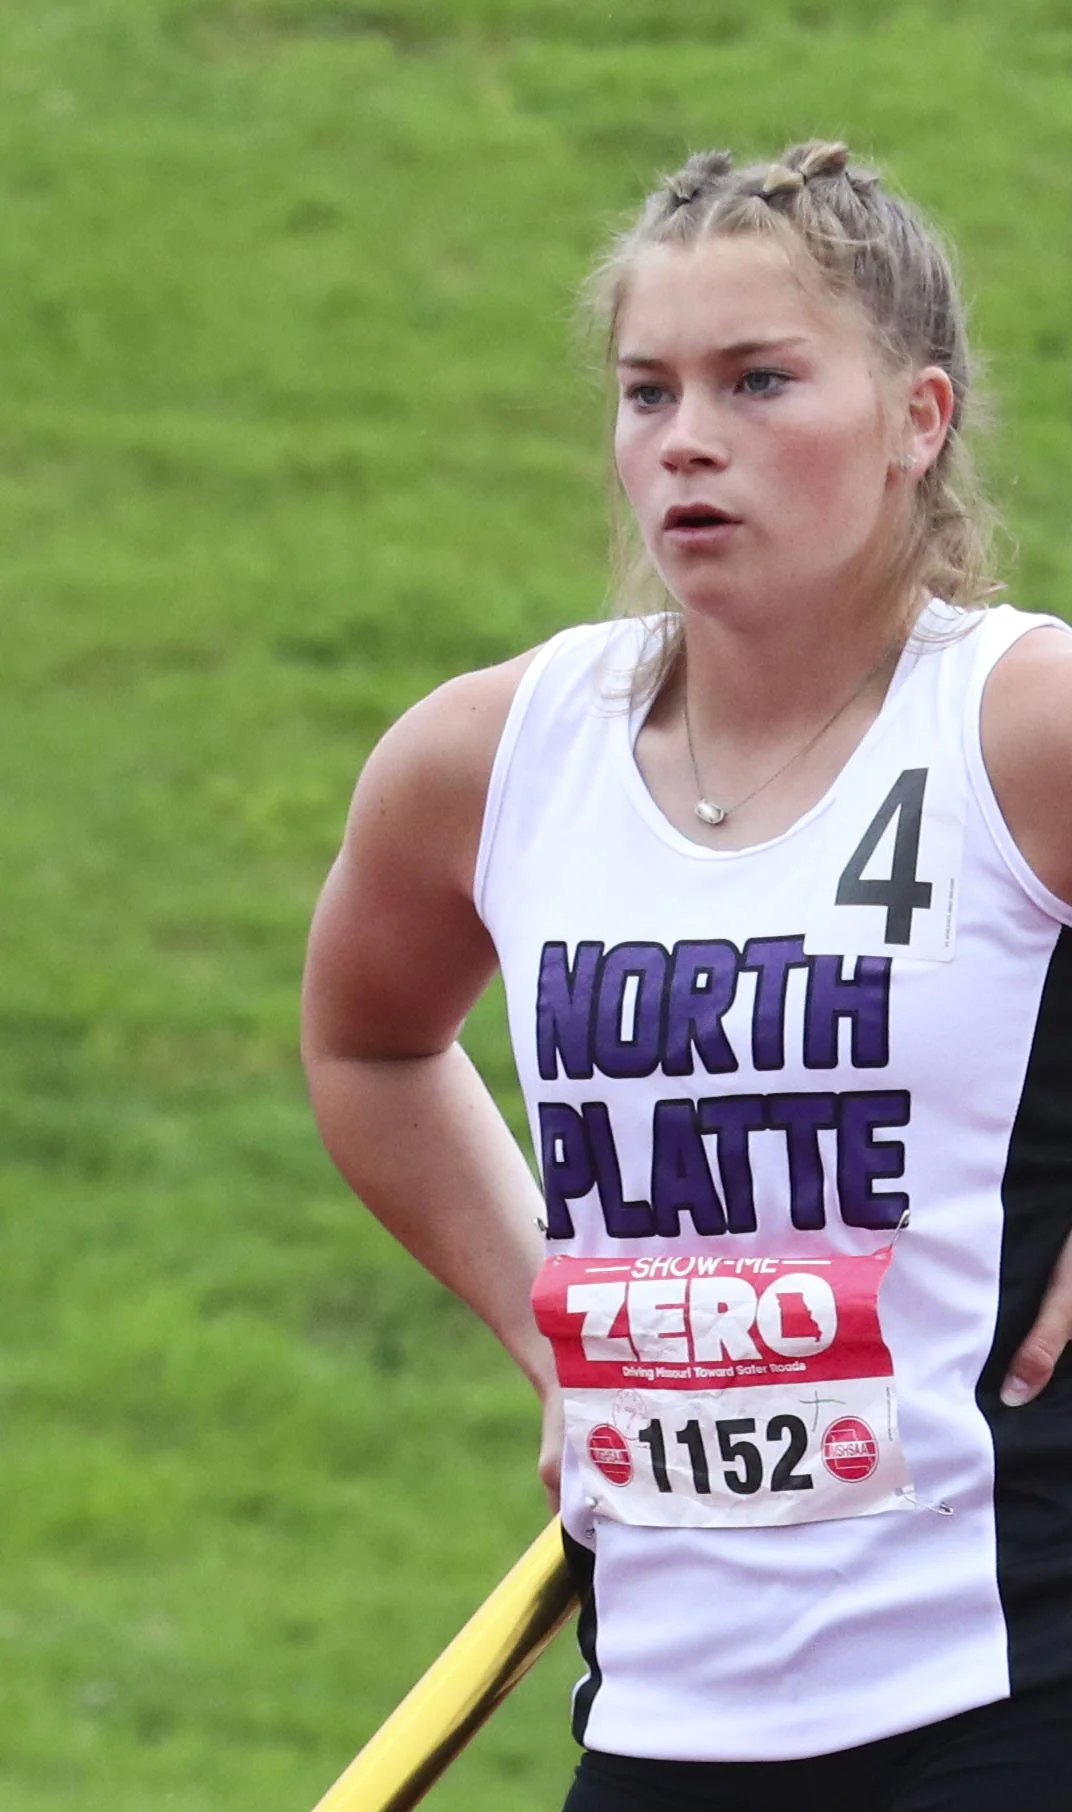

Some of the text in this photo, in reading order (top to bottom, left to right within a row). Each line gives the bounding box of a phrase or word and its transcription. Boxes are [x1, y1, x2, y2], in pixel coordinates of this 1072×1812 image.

[834, 768, 933, 946] 4
[537, 934, 893, 1080] NORTH
[537, 1089, 911, 1240] PLATTE
[631, 1257, 780, 1278] SHOW-ME
[567, 1273, 838, 1363] ZERO
[622, 1366, 654, 1380] Driving
[693, 1366, 735, 1378] Toward
[736, 1365, 767, 1376] Safer
[769, 1361, 807, 1372] Roads
[638, 1414, 814, 1495] 1152
